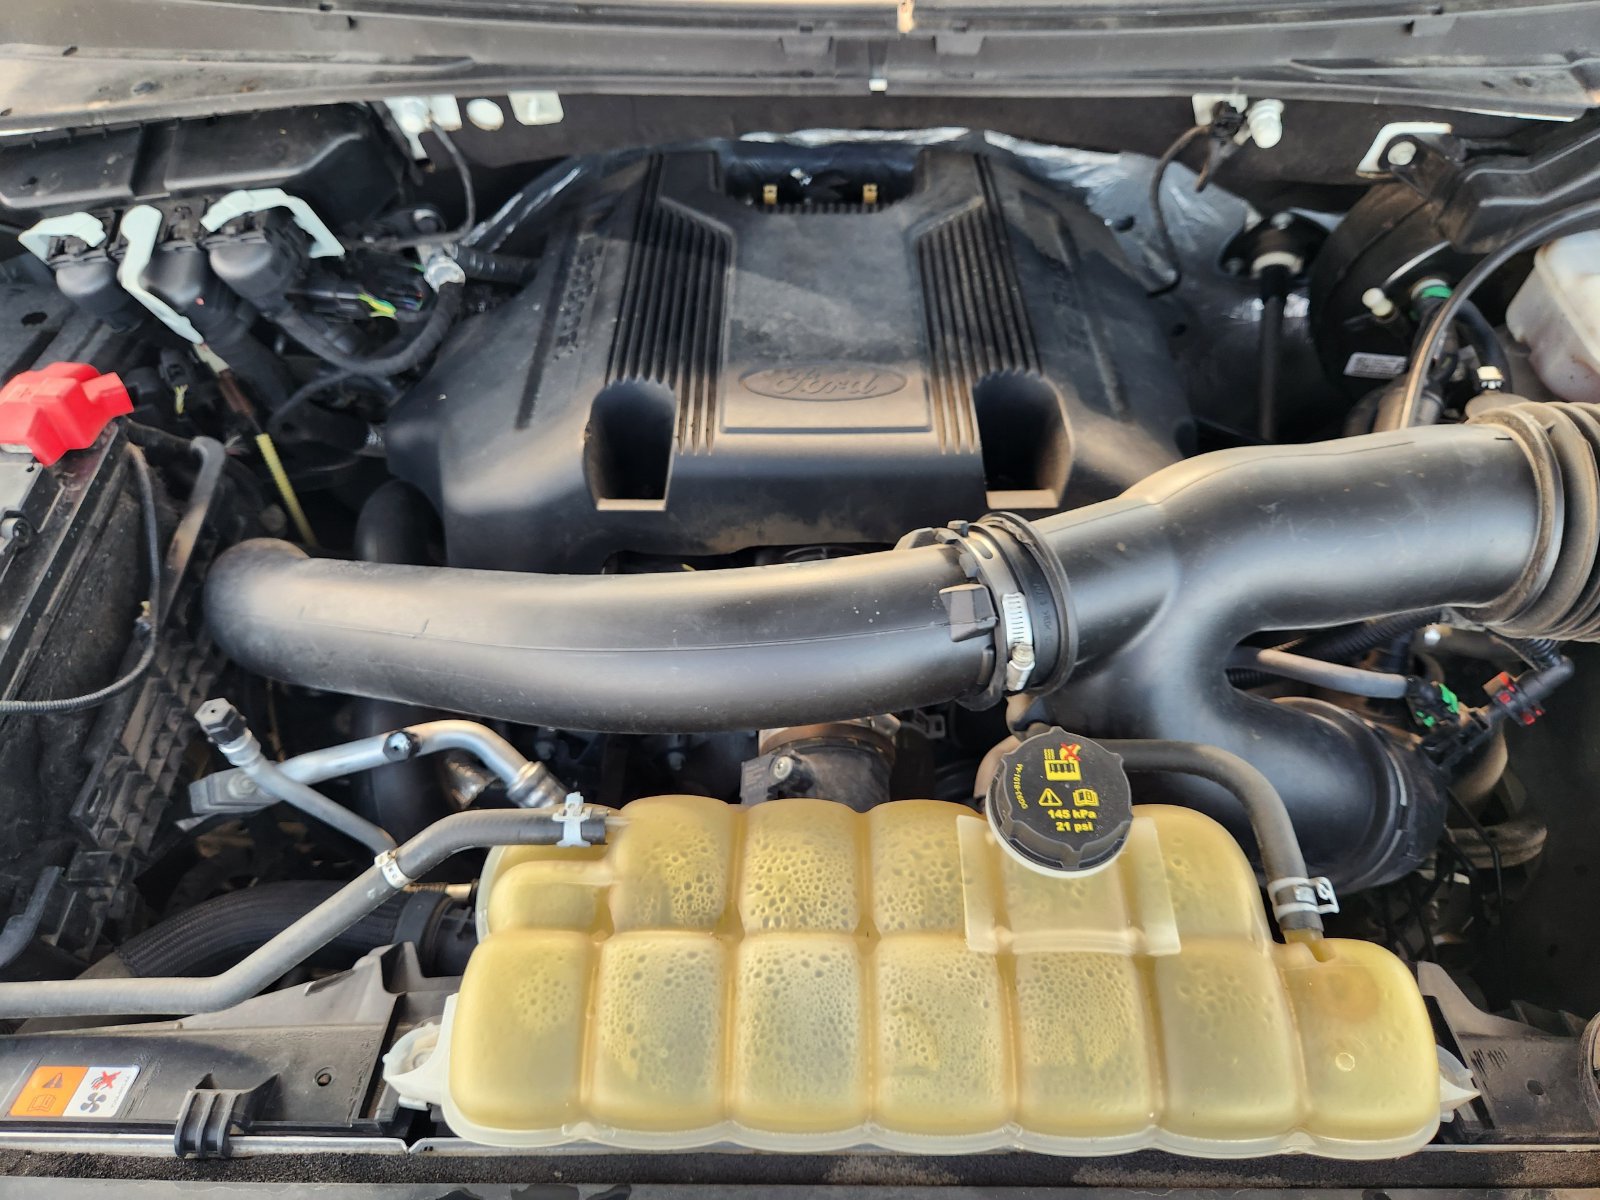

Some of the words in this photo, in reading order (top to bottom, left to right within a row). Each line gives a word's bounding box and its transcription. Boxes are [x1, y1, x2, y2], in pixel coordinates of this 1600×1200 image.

[769, 367, 878, 395] Ford
[1047, 809, 1071, 819] 145
[1072, 809, 1097, 819] kPa
[1055, 821, 1071, 832] 21
[1074, 821, 1094, 833] psi
